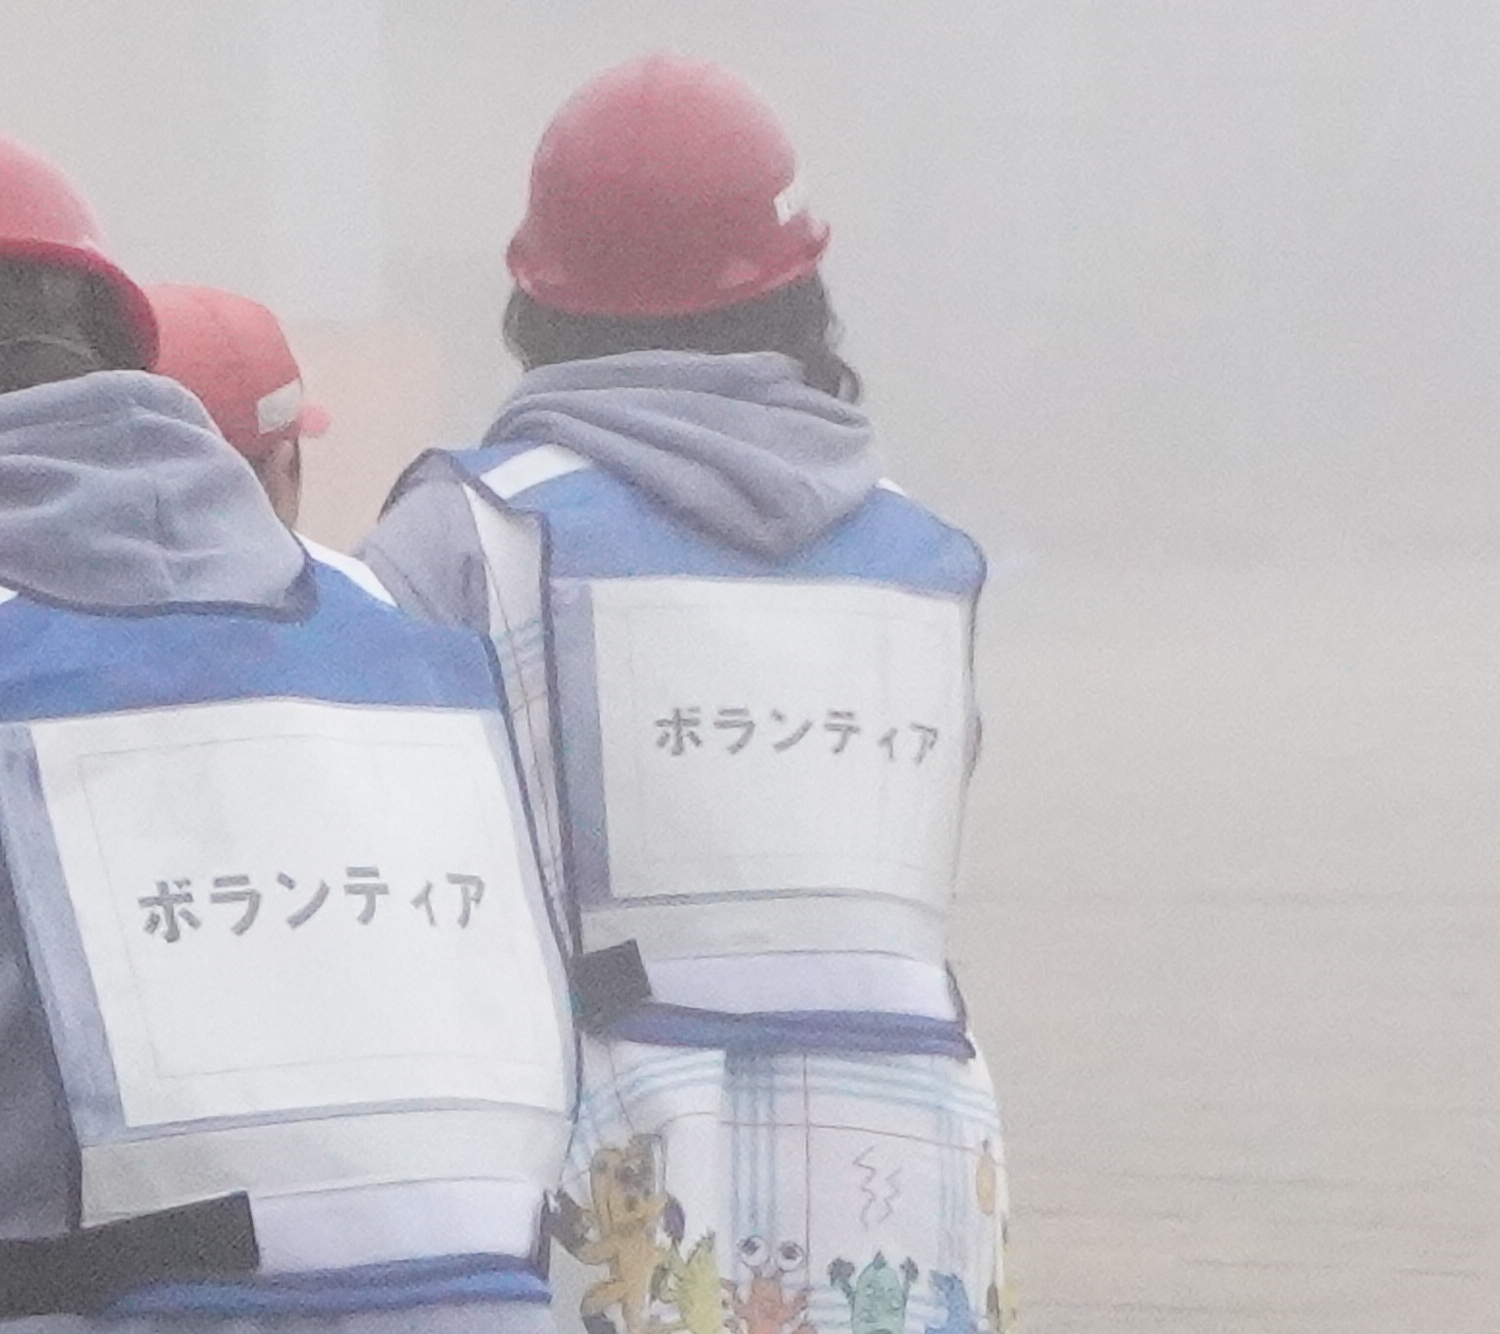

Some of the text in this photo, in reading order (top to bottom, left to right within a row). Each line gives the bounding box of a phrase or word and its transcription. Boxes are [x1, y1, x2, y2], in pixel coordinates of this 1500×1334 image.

[654, 706, 940, 765] ボランティア
[137, 864, 486, 944] ボランティア
